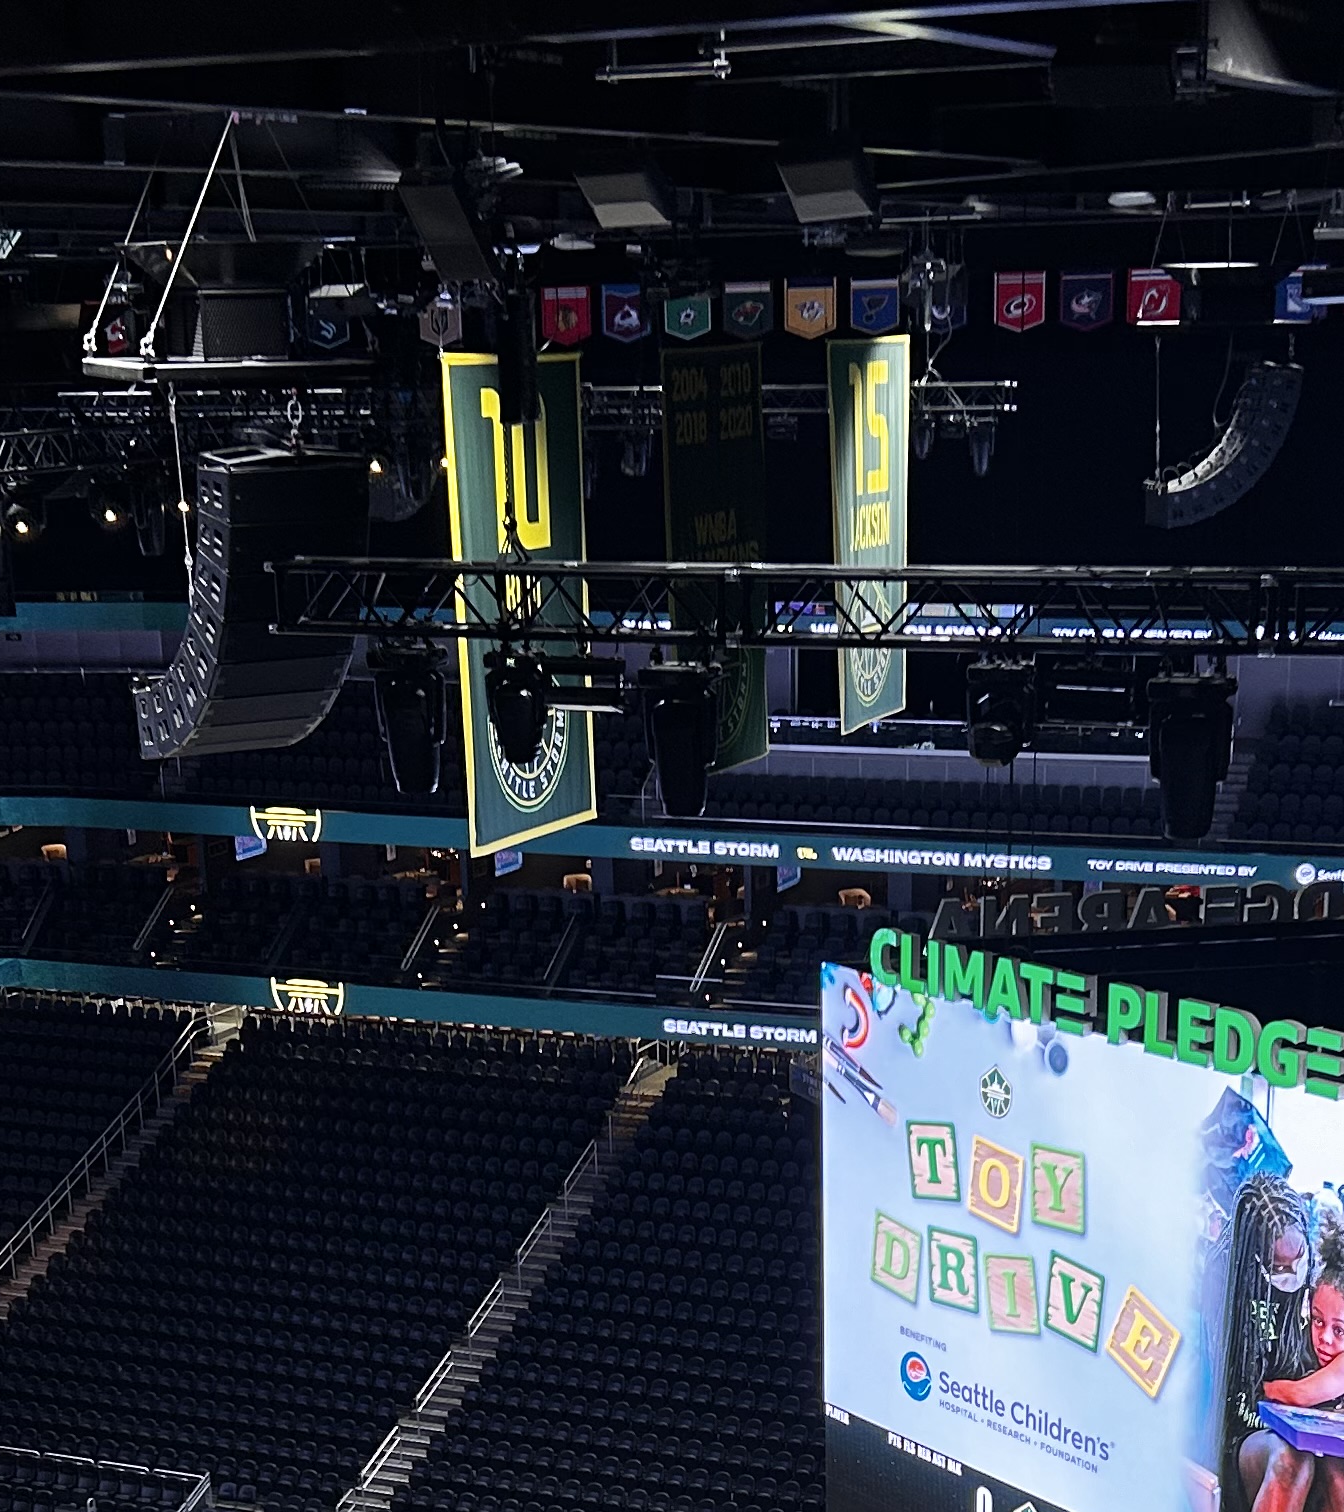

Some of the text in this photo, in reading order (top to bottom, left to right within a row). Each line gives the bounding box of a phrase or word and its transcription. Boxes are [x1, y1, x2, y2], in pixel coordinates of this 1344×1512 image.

[851, 359, 889, 495] 15
[481, 387, 552, 554] 10
[850, 502, 890, 552] JACKSON
[539, 709, 566, 790] STORM
[629, 836, 711, 857] SEATTLE
[713, 841, 780, 859] STORM
[832, 846, 959, 868] WASHINGTON
[963, 851, 1052, 871] MYSTICS
[1087, 859, 1113, 871] TOY
[1115, 861, 1154, 873] DRIVE
[1156, 863, 1235, 876] PRESENTED
[1237, 866, 1257, 878] BY
[870, 926, 1097, 1037] CLIMATE
[663, 1018, 818, 1044] SEATTLE STORM
[916, 1135, 1076, 1214] TOY
[882, 1229, 1163, 1370] DRIVE
[899, 1325, 947, 1352] BENEFITING
[938, 1371, 1110, 1461] Seattle Children's
[939, 1399, 1099, 1474] HOSPITAL RESEARCH FOUNDATION
